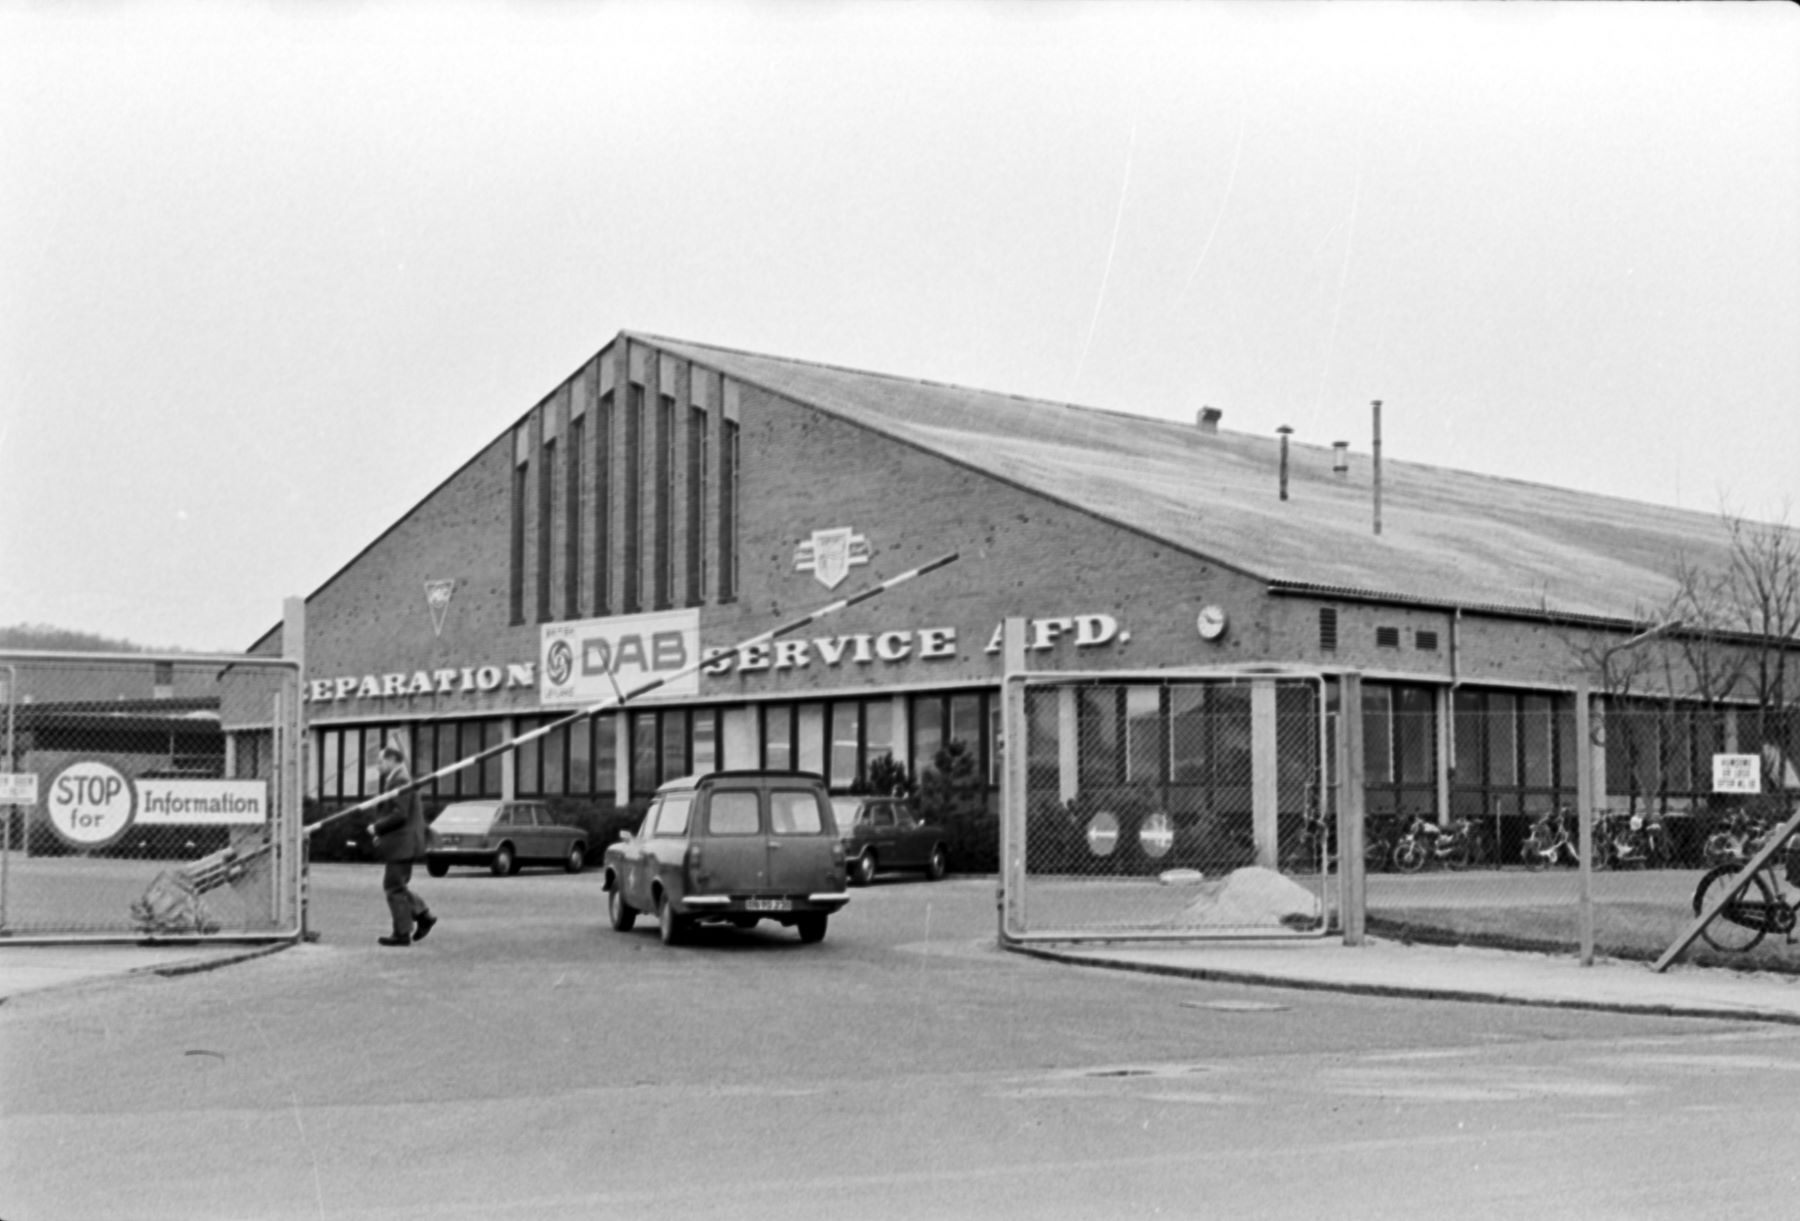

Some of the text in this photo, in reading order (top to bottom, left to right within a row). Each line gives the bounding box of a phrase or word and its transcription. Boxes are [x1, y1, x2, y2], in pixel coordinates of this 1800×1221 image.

[303, 661, 535, 702] EPARATION
[704, 627, 956, 675] SERVICE
[581, 630, 688, 677] DAB
[57, 775, 122, 806] STOP
[144, 790, 259, 816] Information
[70, 808, 104, 829] for
